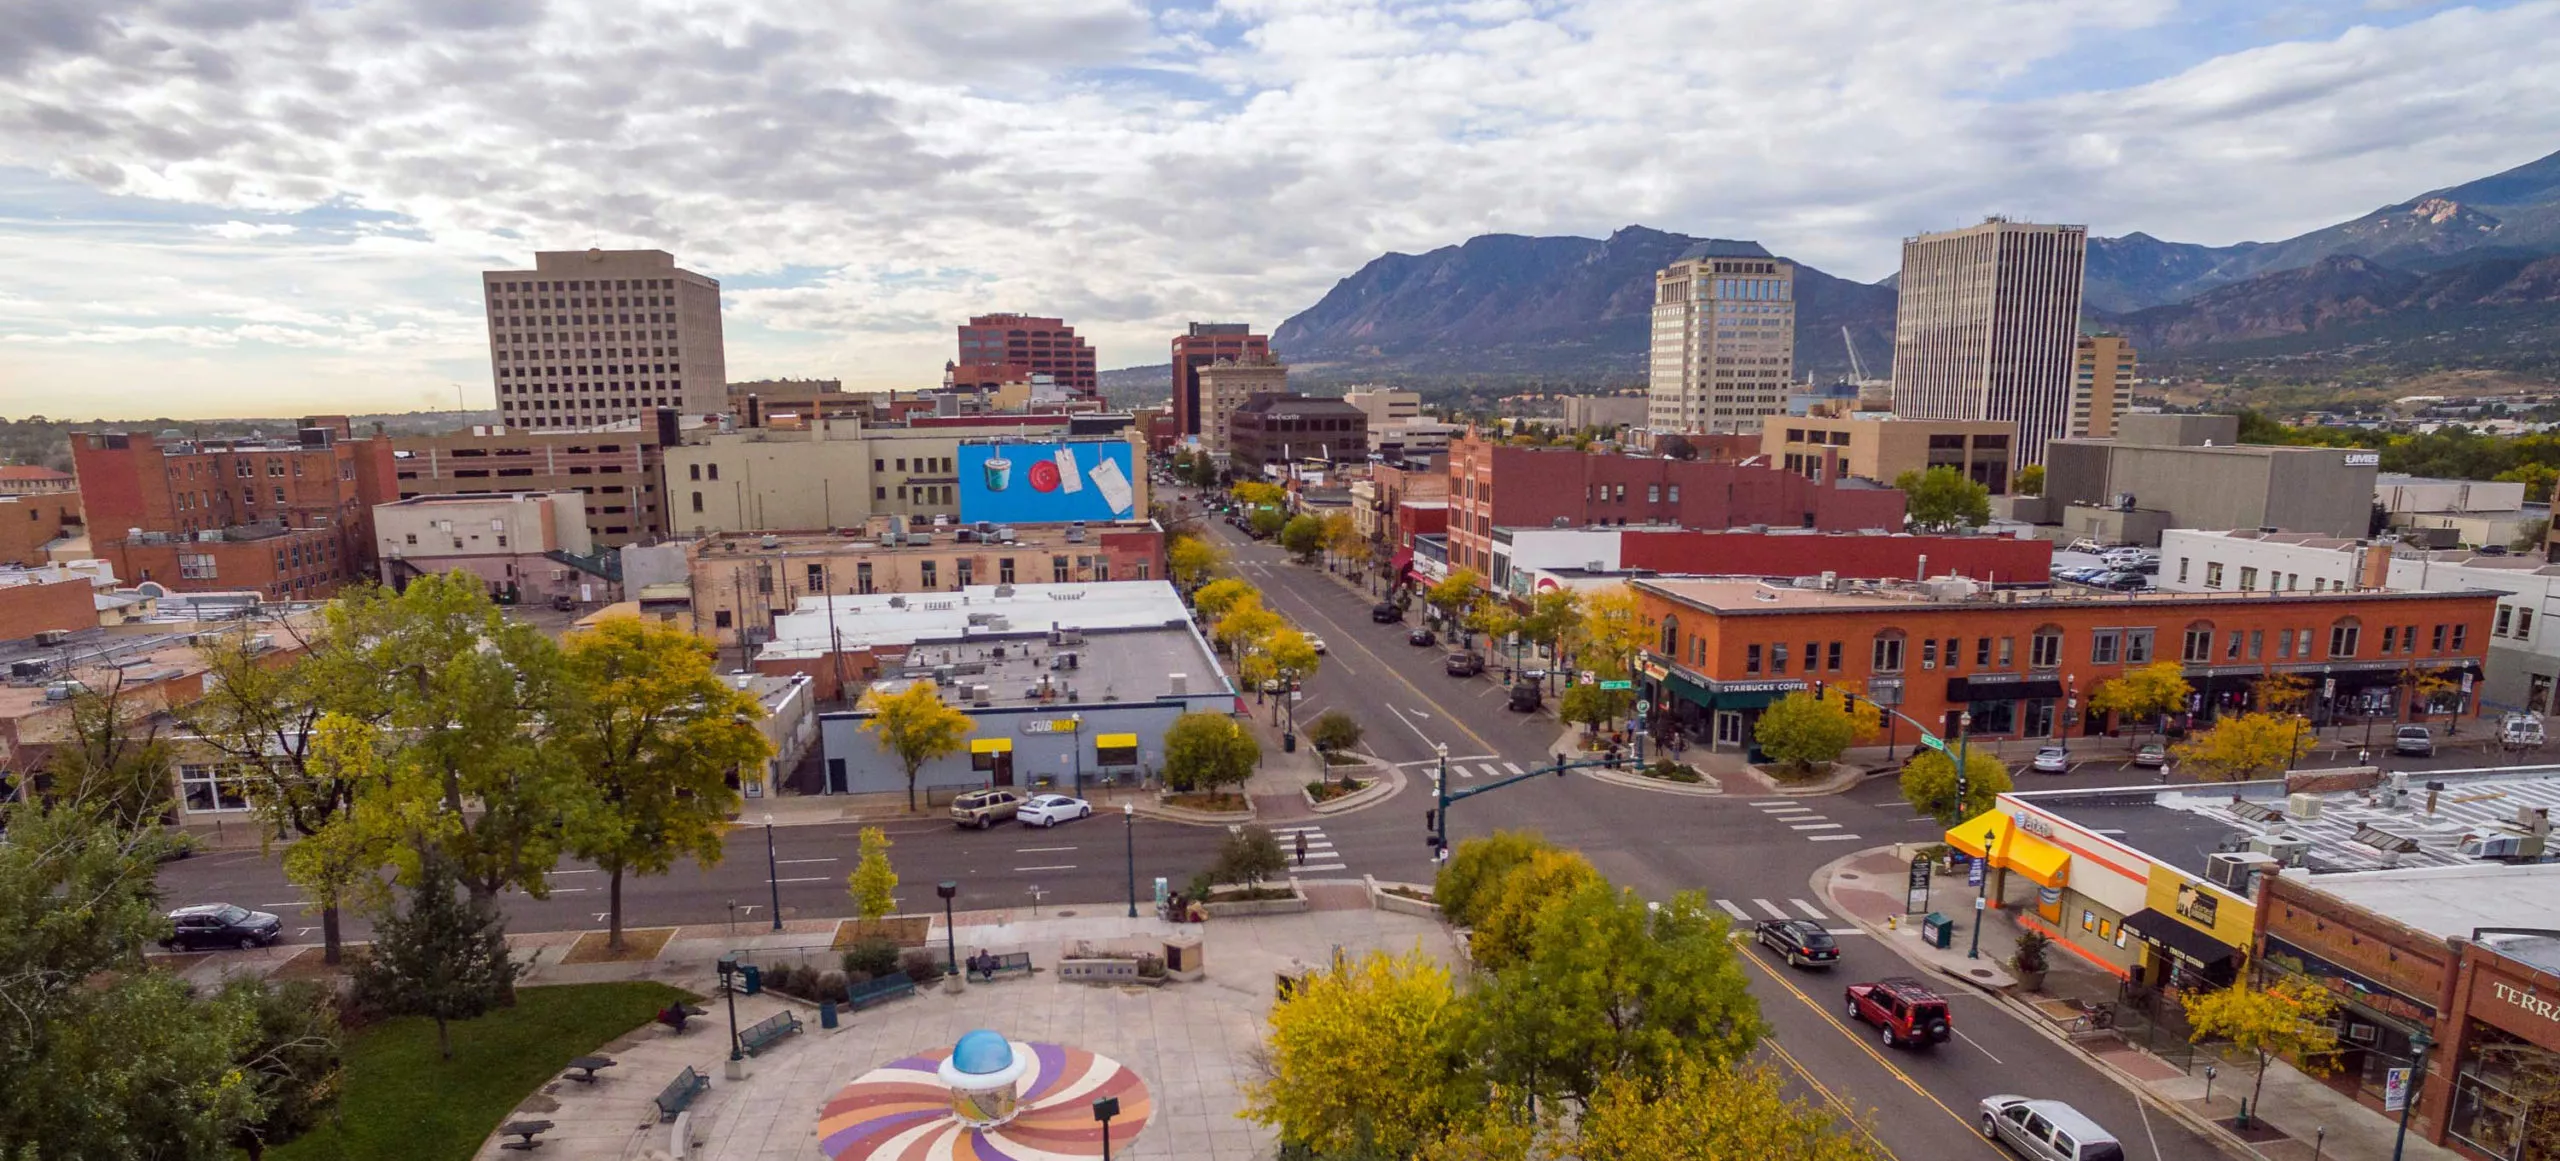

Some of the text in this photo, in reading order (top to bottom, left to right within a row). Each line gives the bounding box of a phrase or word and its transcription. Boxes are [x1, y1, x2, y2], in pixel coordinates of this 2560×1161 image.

[2345, 454, 2379, 463] UMB
[1723, 682, 1809, 693] STARBUCKS COFFEE
